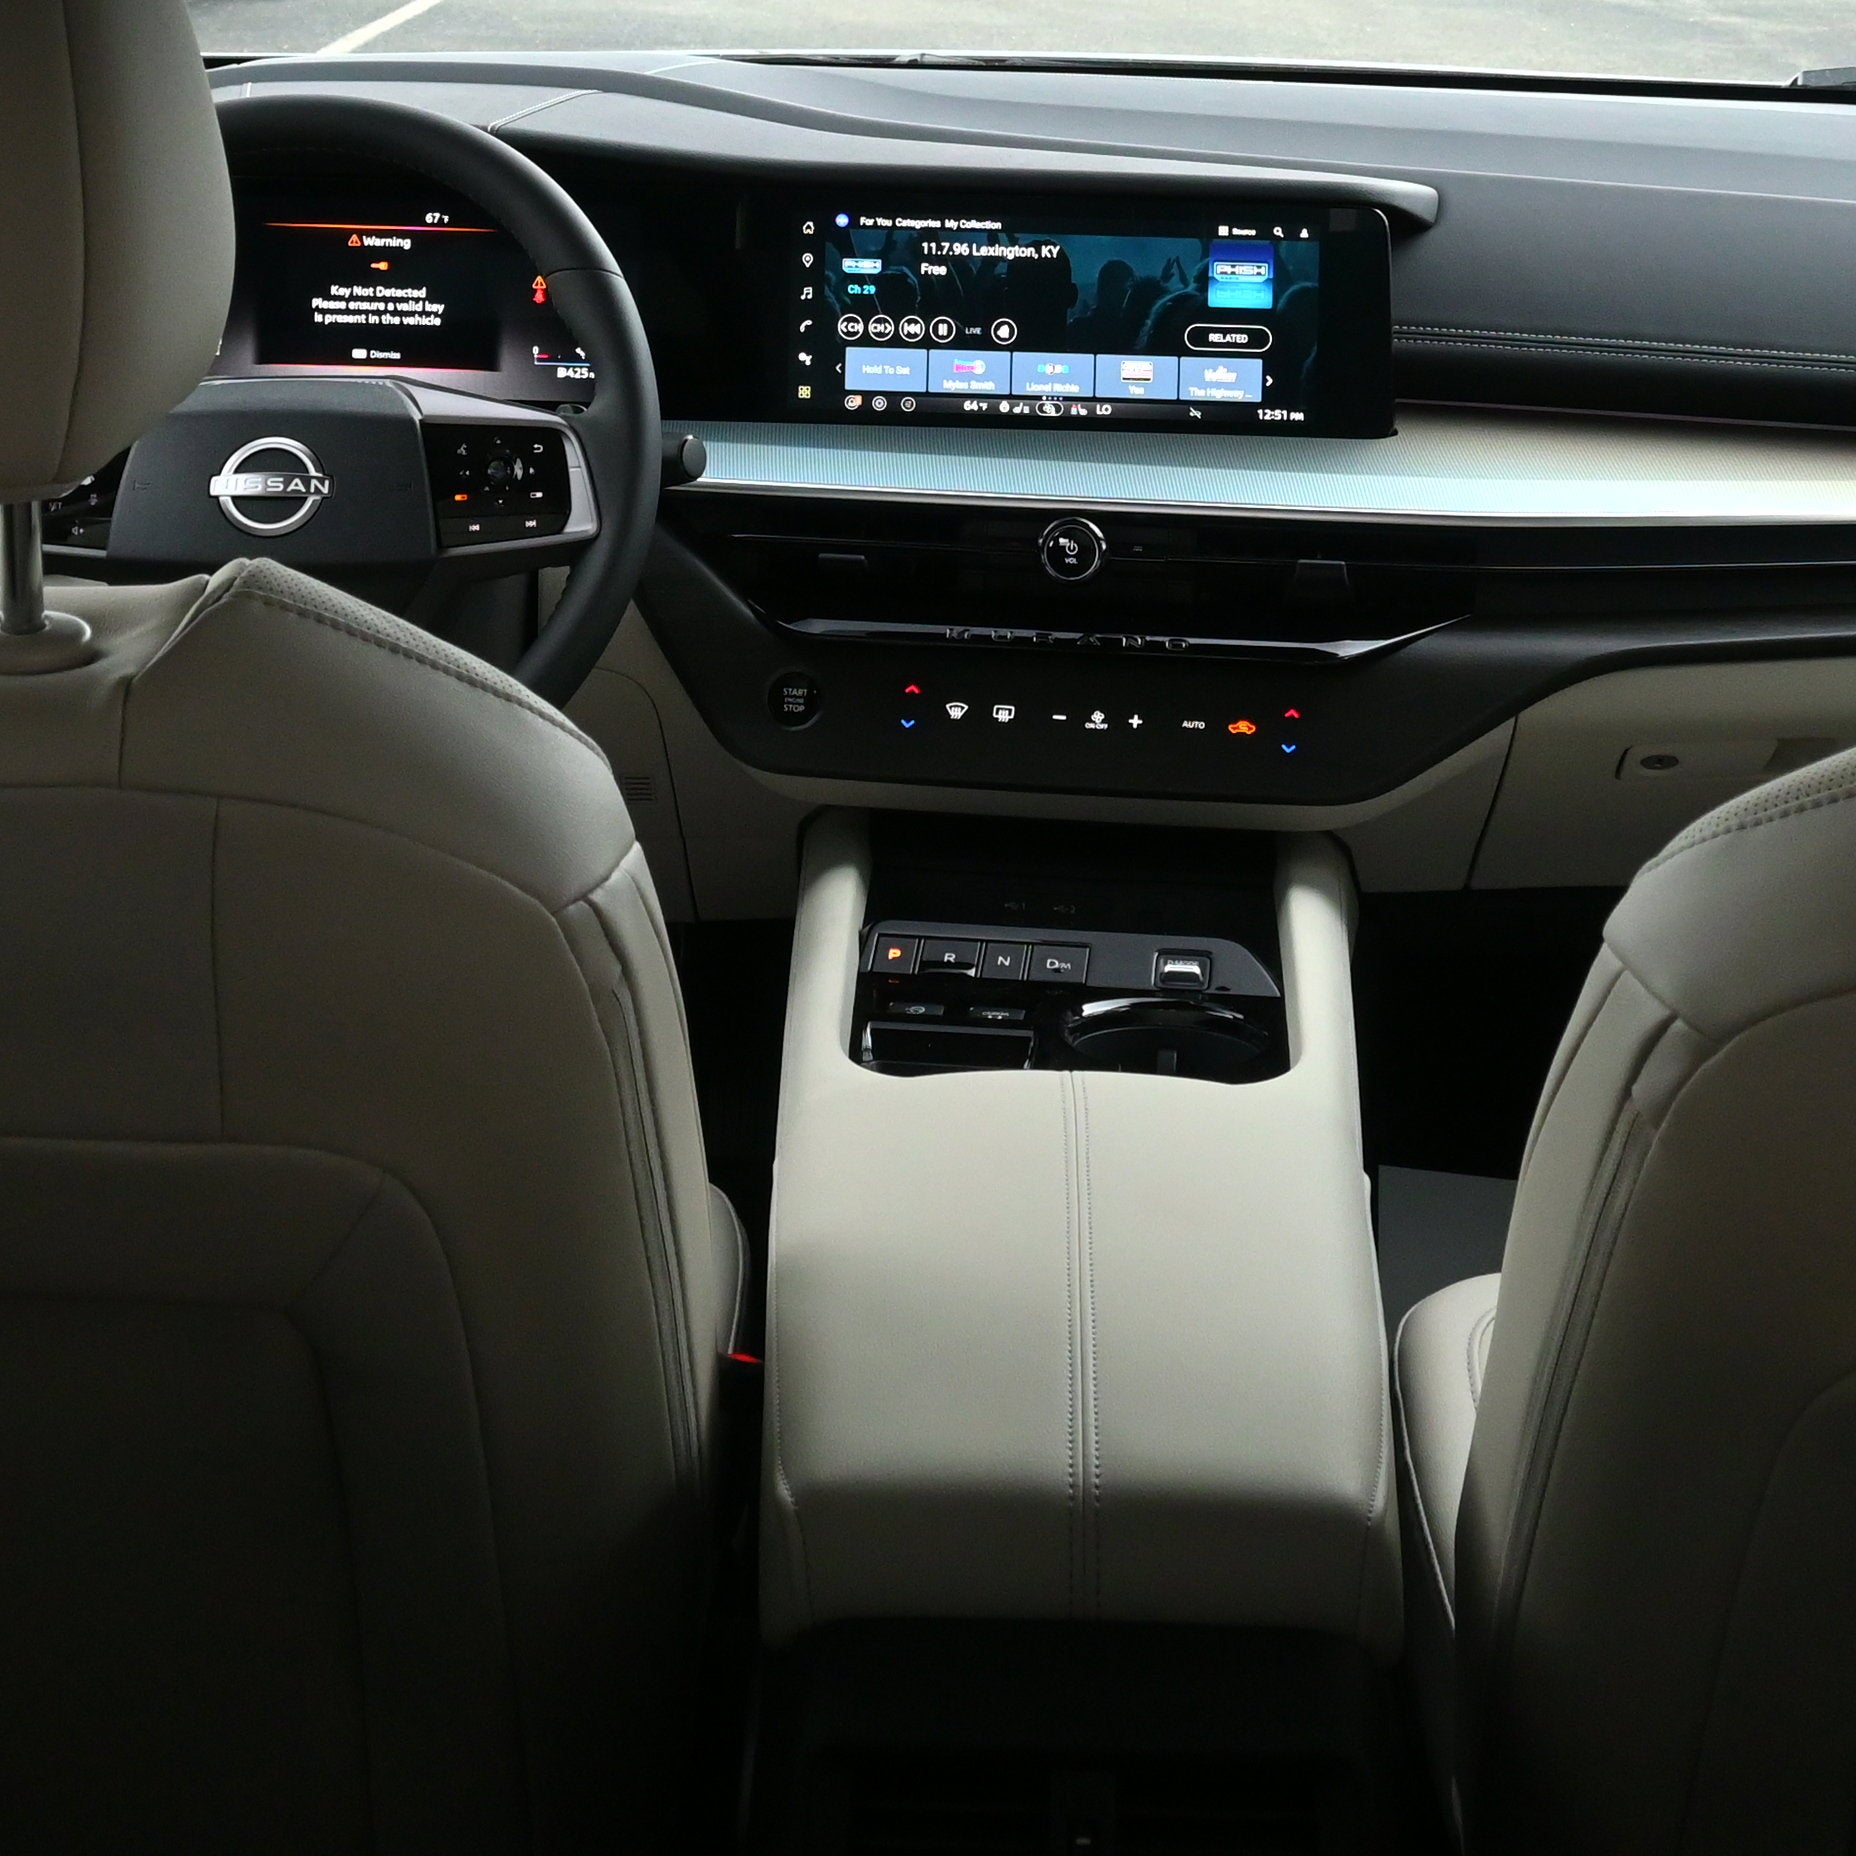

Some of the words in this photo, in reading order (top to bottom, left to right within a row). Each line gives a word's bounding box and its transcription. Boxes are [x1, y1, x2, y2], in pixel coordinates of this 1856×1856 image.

[424, 212, 441, 224] 67
[860, 217, 874, 226] For
[876, 217, 892, 227] You
[895, 218, 941, 229] Categories
[945, 219, 958, 230] My
[959, 219, 1002, 230] Collection
[362, 235, 412, 250] Warning
[921, 242, 970, 256] 11.7.96
[972, 244, 1039, 260] Lexington,
[1041, 245, 1060, 258] KY
[920, 263, 947, 276] Free
[330, 285, 352, 299] Key
[353, 285, 374, 298] Not
[376, 286, 427, 299] Detected
[847, 284, 861, 295] Ch
[863, 284, 876, 295] 29
[311, 297, 346, 310] Please
[348, 301, 386, 311] ensure
[396, 300, 423, 312] valid
[425, 301, 445, 315] key
[314, 312, 323, 323] is
[324, 313, 367, 325] present
[368, 313, 380, 324] in
[381, 313, 401, 326] the
[402, 314, 442, 326] vehicle
[965, 327, 982, 335] LIVE
[1208, 333, 1249, 344] RELATED
[369, 350, 402, 359] Dismiss
[862, 365, 882, 375] Hold
[883, 365, 894, 375] To
[896, 366, 911, 376] Set
[970, 380, 995, 390] Smith
[1026, 382, 1052, 392] Lionel
[1188, 386, 1205, 397] The
[1206, 388, 1245, 399] Highway
[963, 401, 978, 411] 64
[1096, 405, 1112, 415] LO
[1257, 409, 1288, 421] 12:51
[1290, 412, 1304, 422] PM
[213, 477, 329, 494] NISSAN
[945, 627, 1190, 652] MURANO
[783, 687, 808, 696] START
[783, 704, 805, 712] STOP
[1182, 719, 1206, 729] AUTO
[888, 947, 902, 960] P
[944, 952, 956, 963] R
[997, 955, 1011, 966] N
